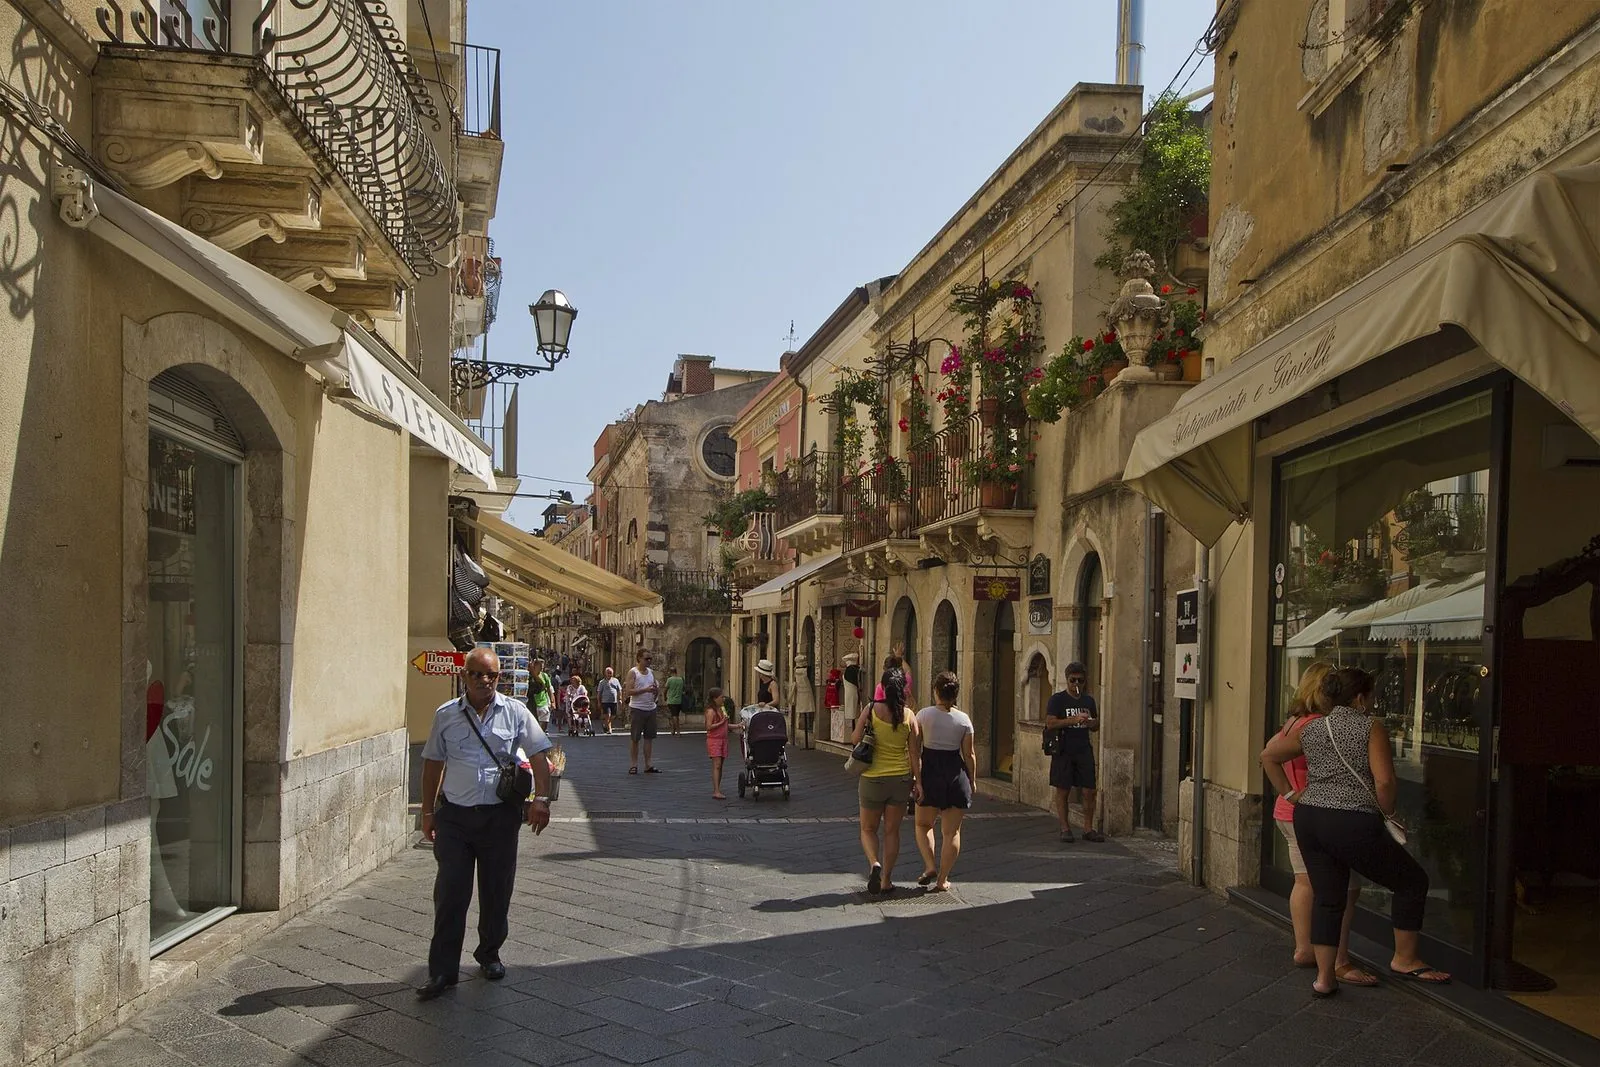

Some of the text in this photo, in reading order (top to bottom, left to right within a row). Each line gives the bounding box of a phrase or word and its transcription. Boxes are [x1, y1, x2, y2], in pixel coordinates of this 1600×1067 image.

[1253, 383, 1265, 403] e
[1269, 325, 1337, 395] Gioielli
[382, 374, 484, 475] STEFANEL
[427, 663, 462, 673] Corle
[428, 653, 453, 663] Don
[162, 711, 213, 791] Sale
